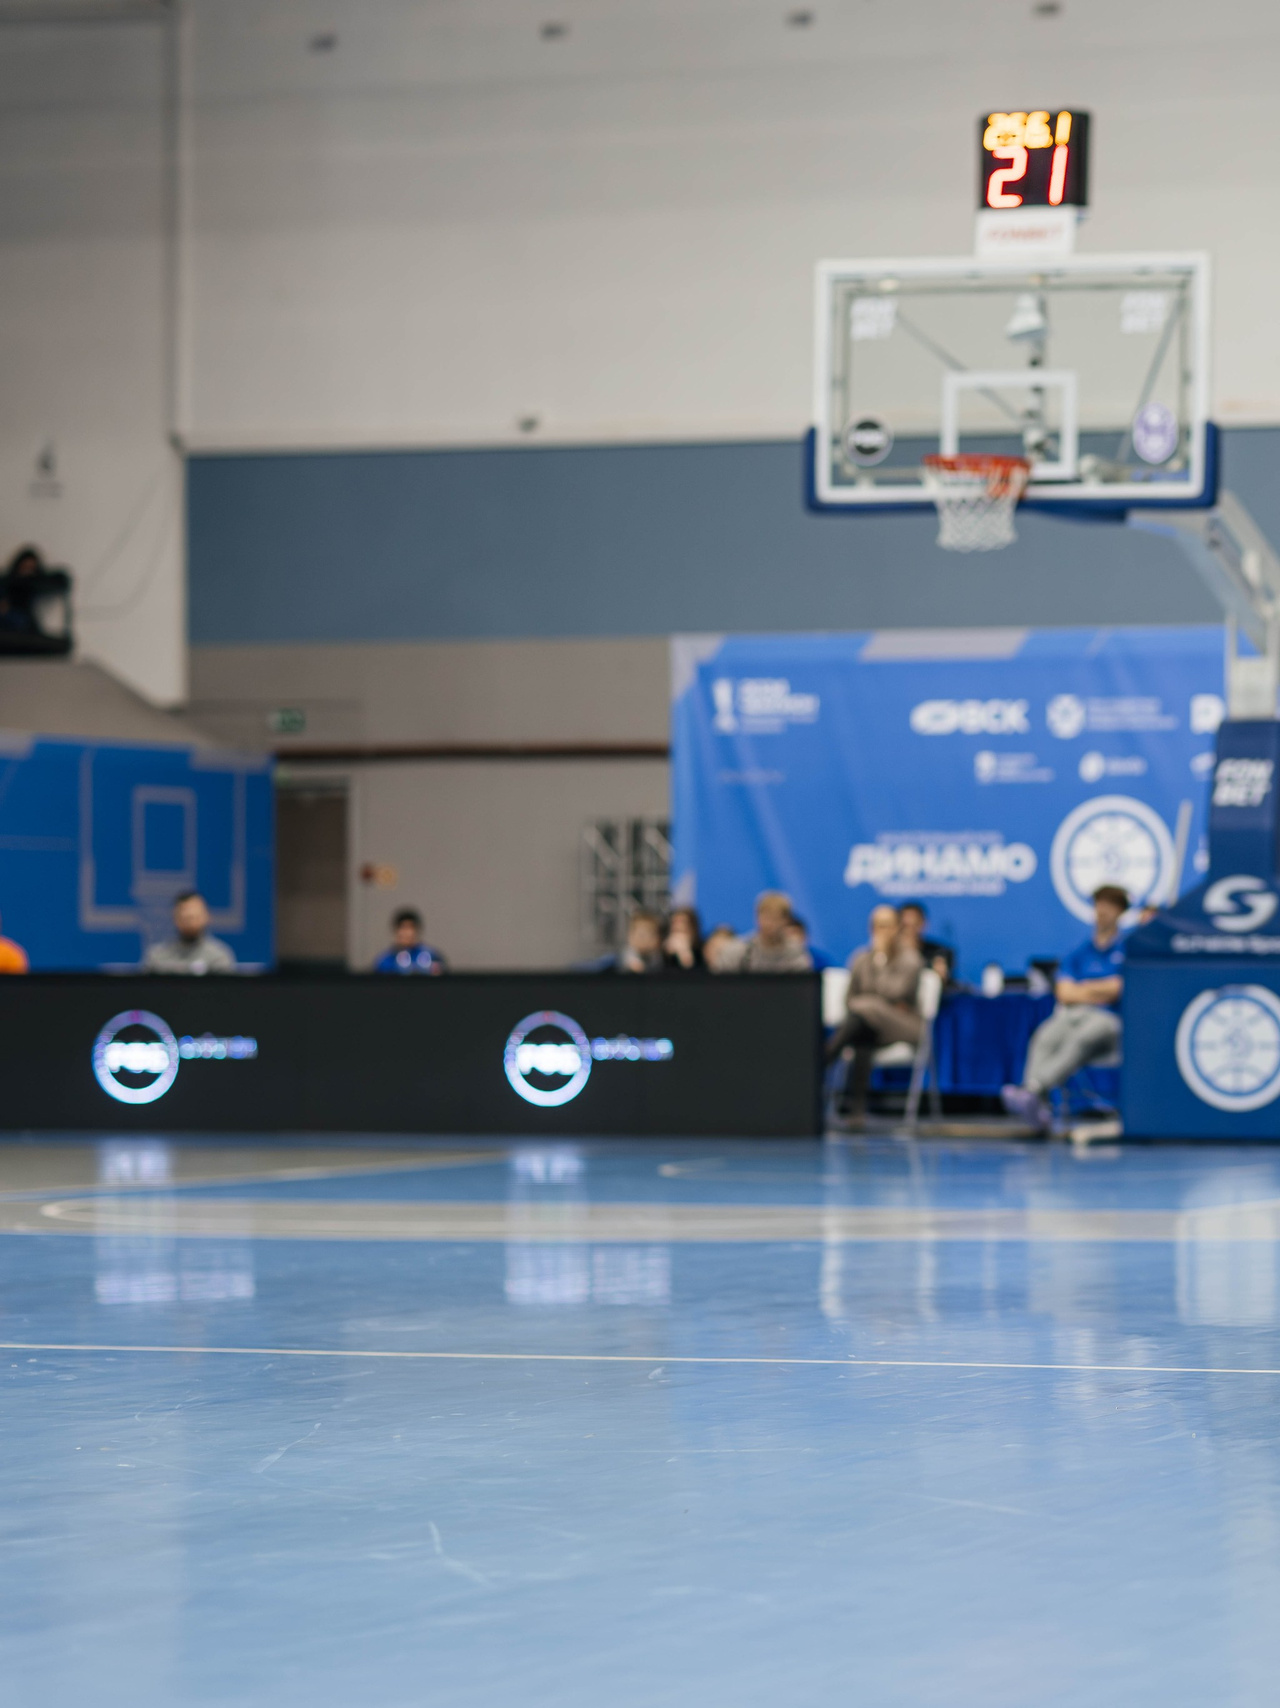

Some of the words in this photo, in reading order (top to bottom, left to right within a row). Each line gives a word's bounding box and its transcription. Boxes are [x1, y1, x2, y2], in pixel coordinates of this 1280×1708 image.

[986, 145, 1069, 209] 21
[1215, 758, 1275, 782] FON
[1213, 780, 1272, 806] BET
[843, 842, 1038, 888] ДИНАМО
